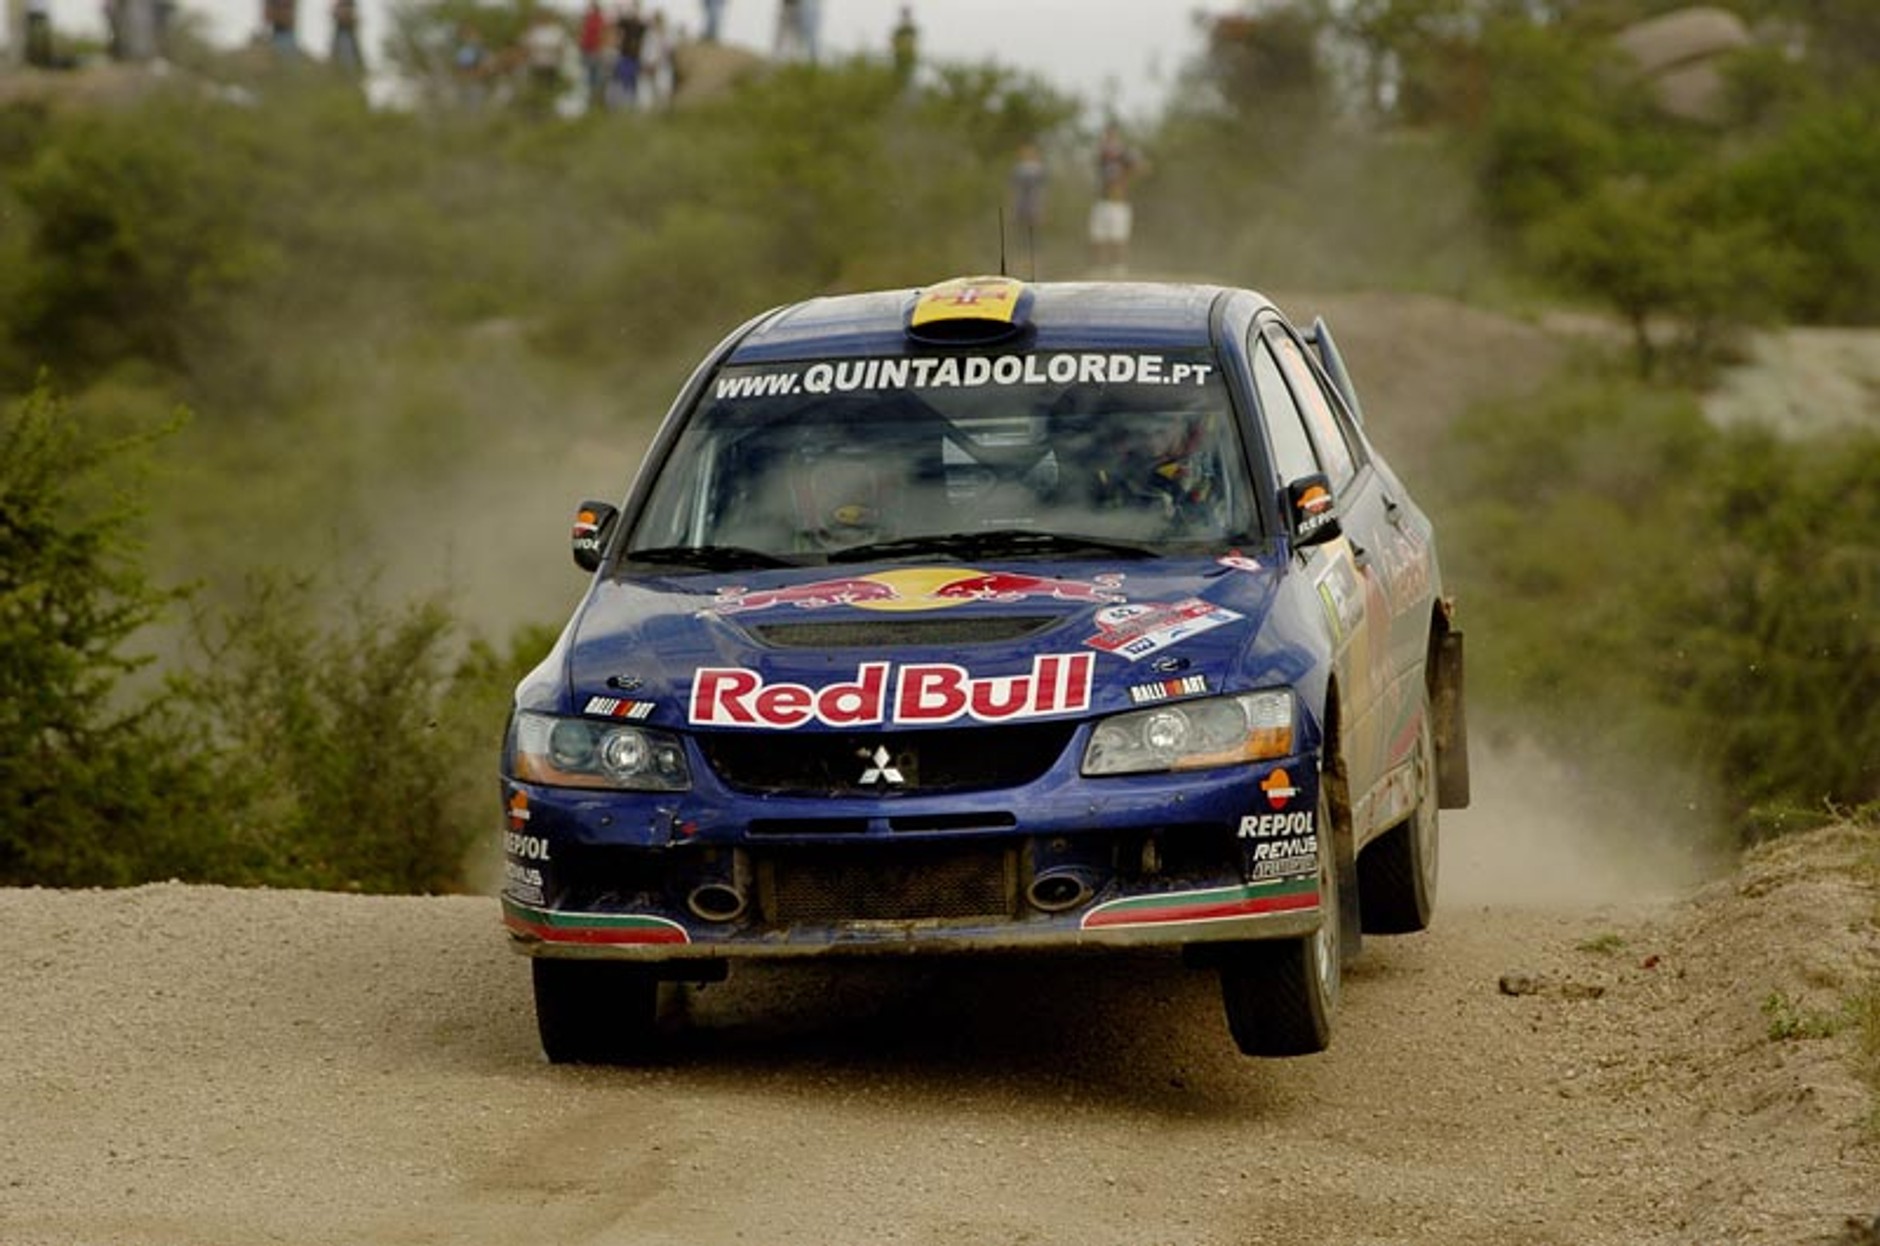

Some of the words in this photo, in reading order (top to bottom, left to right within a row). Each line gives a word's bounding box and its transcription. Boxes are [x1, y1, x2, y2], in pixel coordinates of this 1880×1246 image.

[690, 663, 888, 728] Red
[893, 652, 1096, 724] Bull
[1238, 811, 1314, 837] REPSOL
[1252, 834, 1318, 861] REMUS
